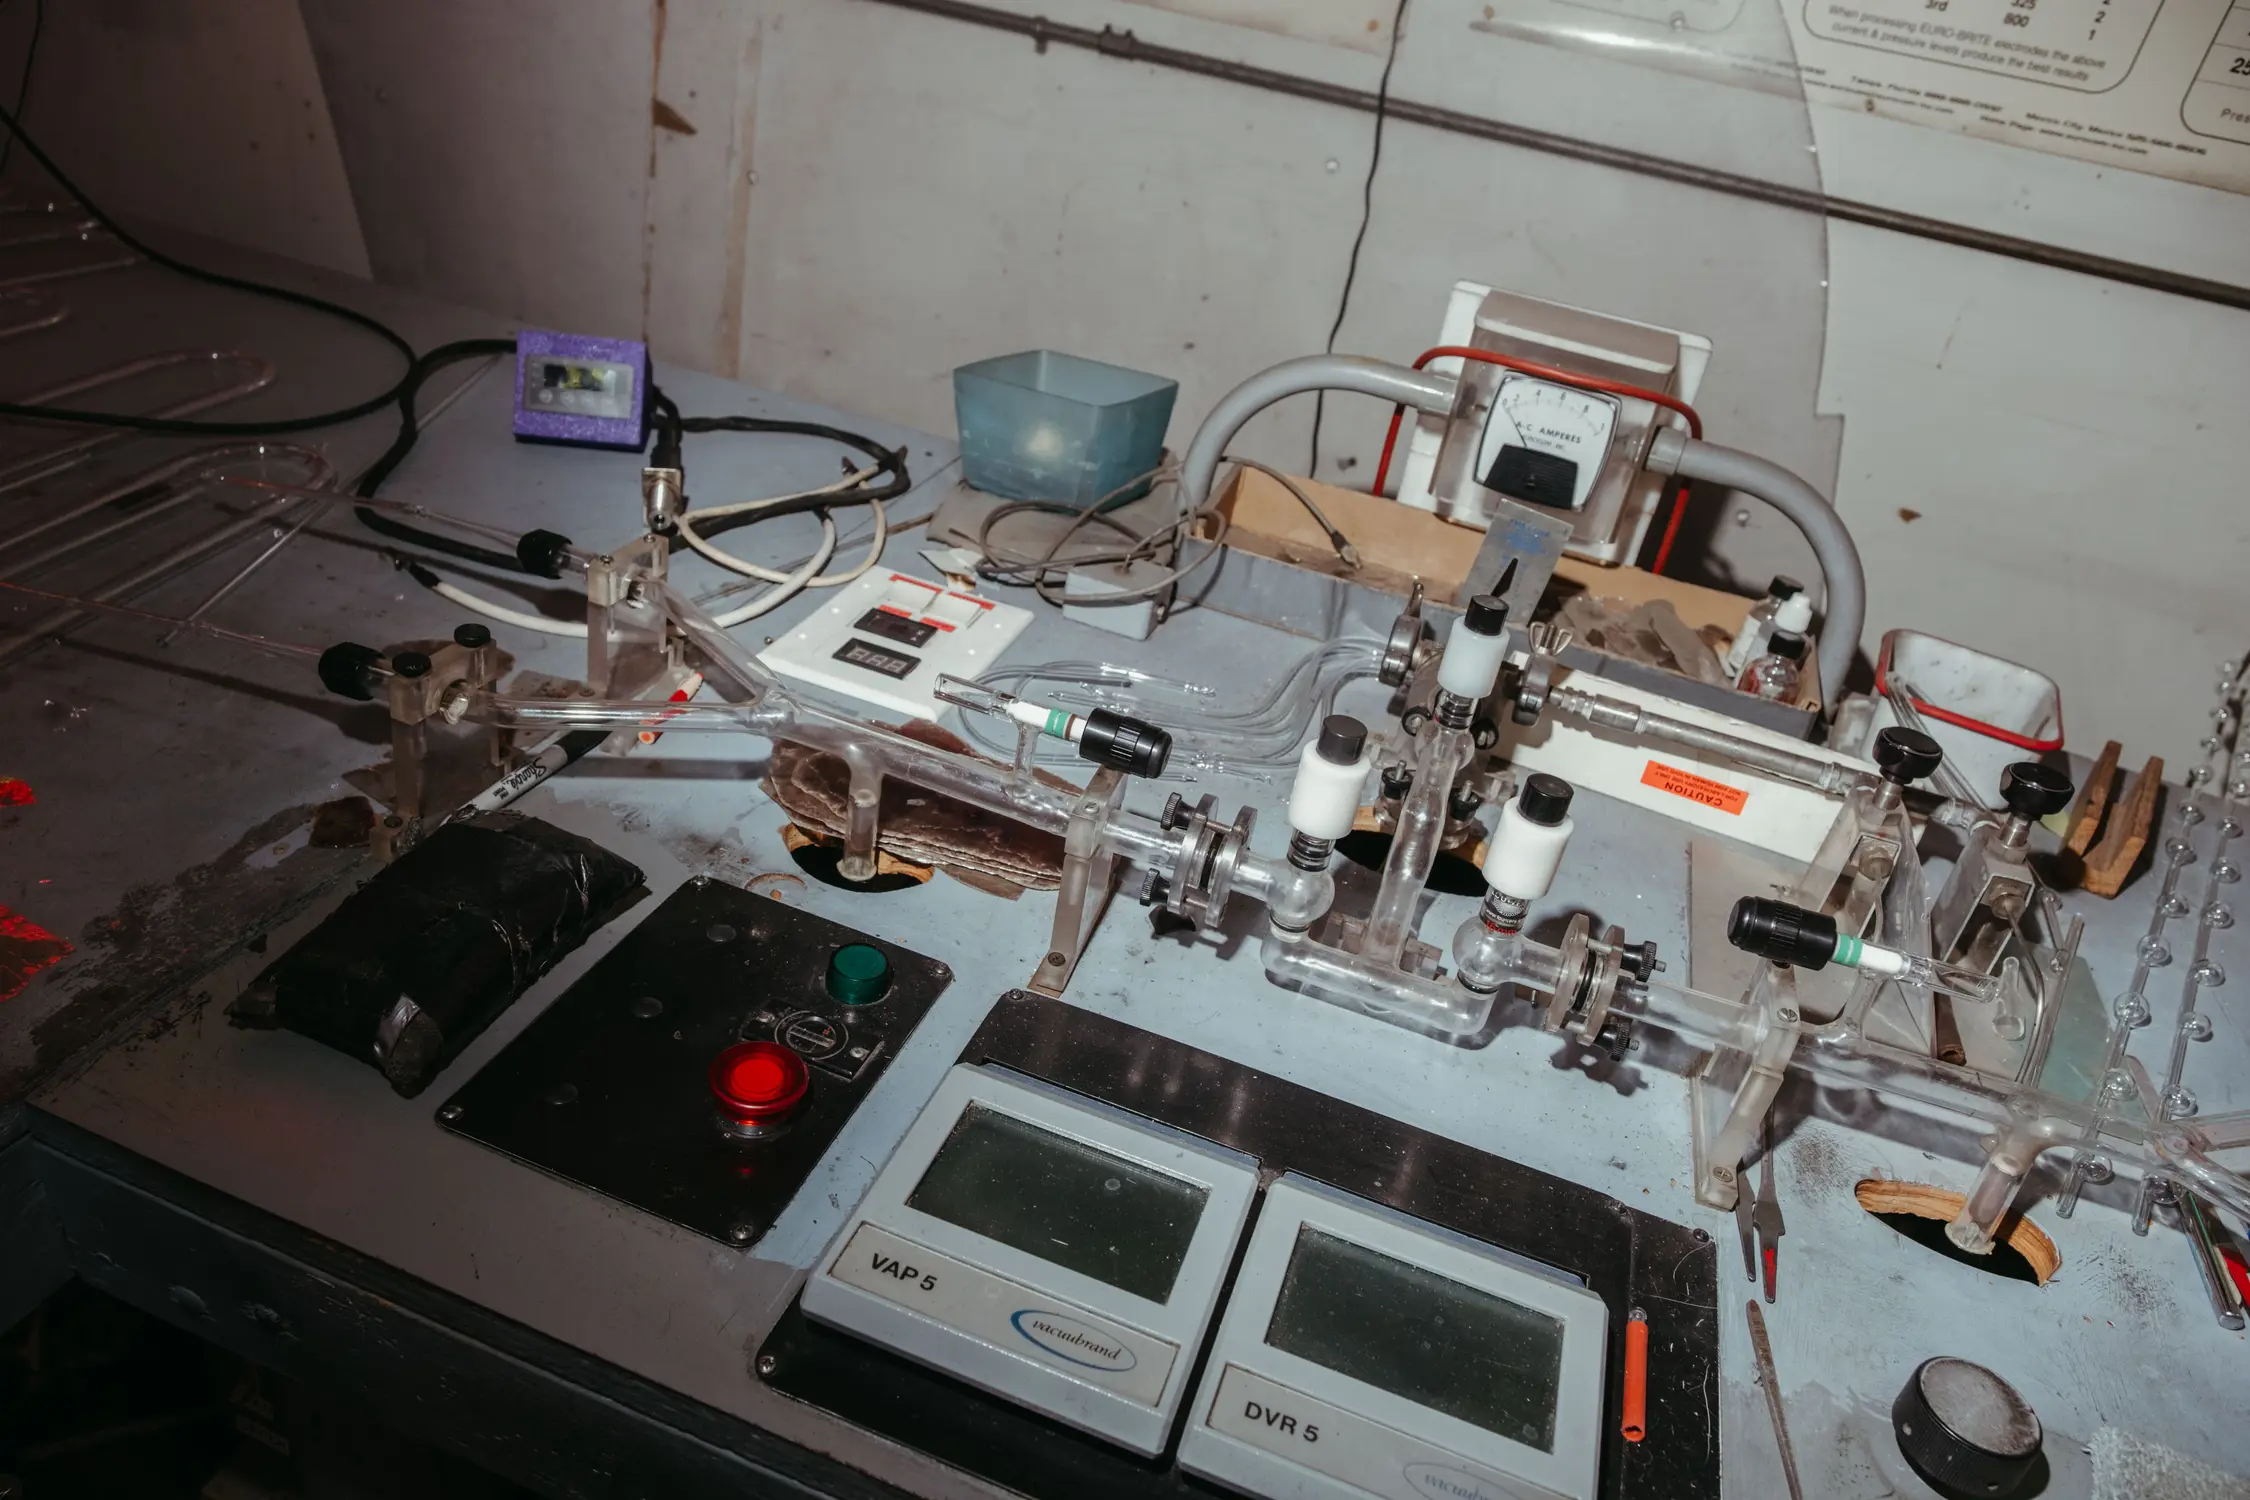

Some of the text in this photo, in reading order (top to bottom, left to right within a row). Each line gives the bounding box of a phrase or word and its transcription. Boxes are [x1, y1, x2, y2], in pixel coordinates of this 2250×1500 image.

[2094, 10, 2106, 24] 2
[1860, 13, 1917, 33] processing
[1994, 40, 2049, 58] electrodes
[2052, 50, 2069, 62] the
[2071, 55, 2106, 69] above
[1880, 32, 1926, 48] pressure
[1929, 42, 1959, 56] levels
[1961, 49, 2005, 65] produce
[2007, 57, 2025, 68] the
[2027, 61, 2051, 74] best
[2053, 67, 2089, 82] results
[1540, 427, 1581, 444] AMPERES
[507, 756, 547, 790] Sharpie
[1664, 781, 1723, 806] CAUTION
[871, 1252, 938, 1291] VAP 5
[1032, 1318, 1121, 1361] vacuubrand
[1244, 1401, 1320, 1443] DVR 5
